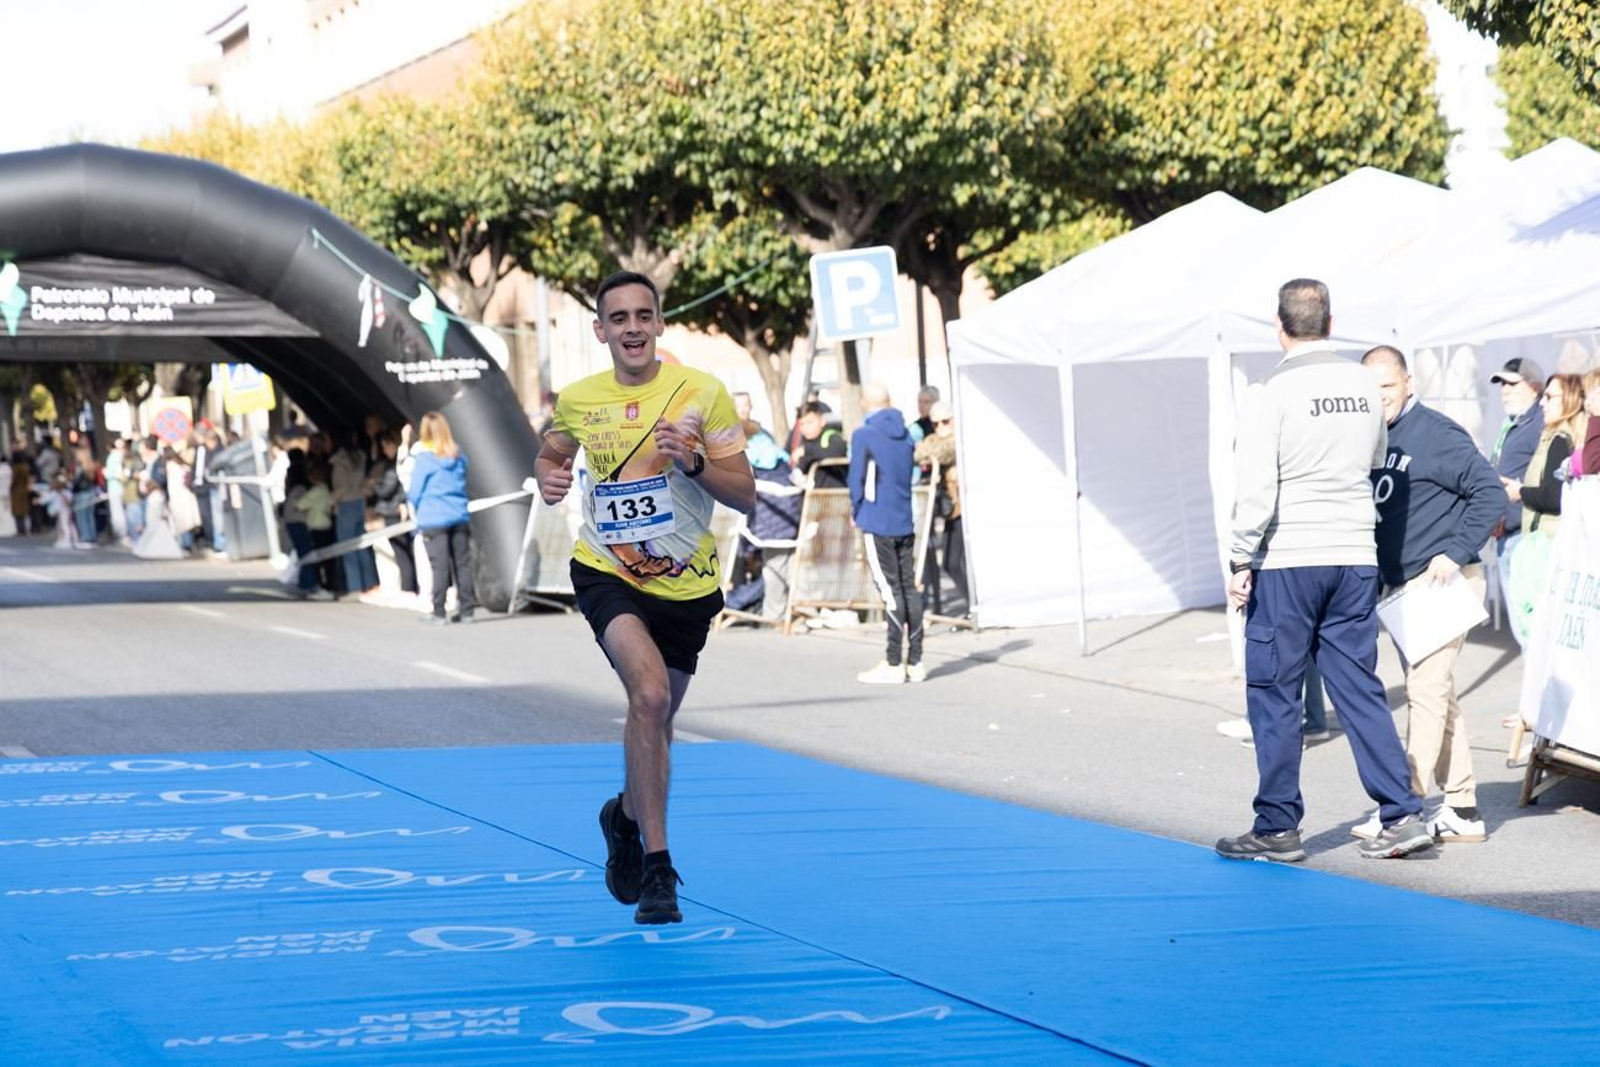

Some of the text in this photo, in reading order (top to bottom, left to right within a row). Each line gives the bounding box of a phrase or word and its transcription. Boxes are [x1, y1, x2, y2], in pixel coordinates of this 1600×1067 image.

[31, 286, 215, 306] Patronato Municipal de
[31, 304, 173, 323] Deportes de Jaén
[607, 496, 656, 521] 133
[282, 1027, 519, 1049] MEDIA
